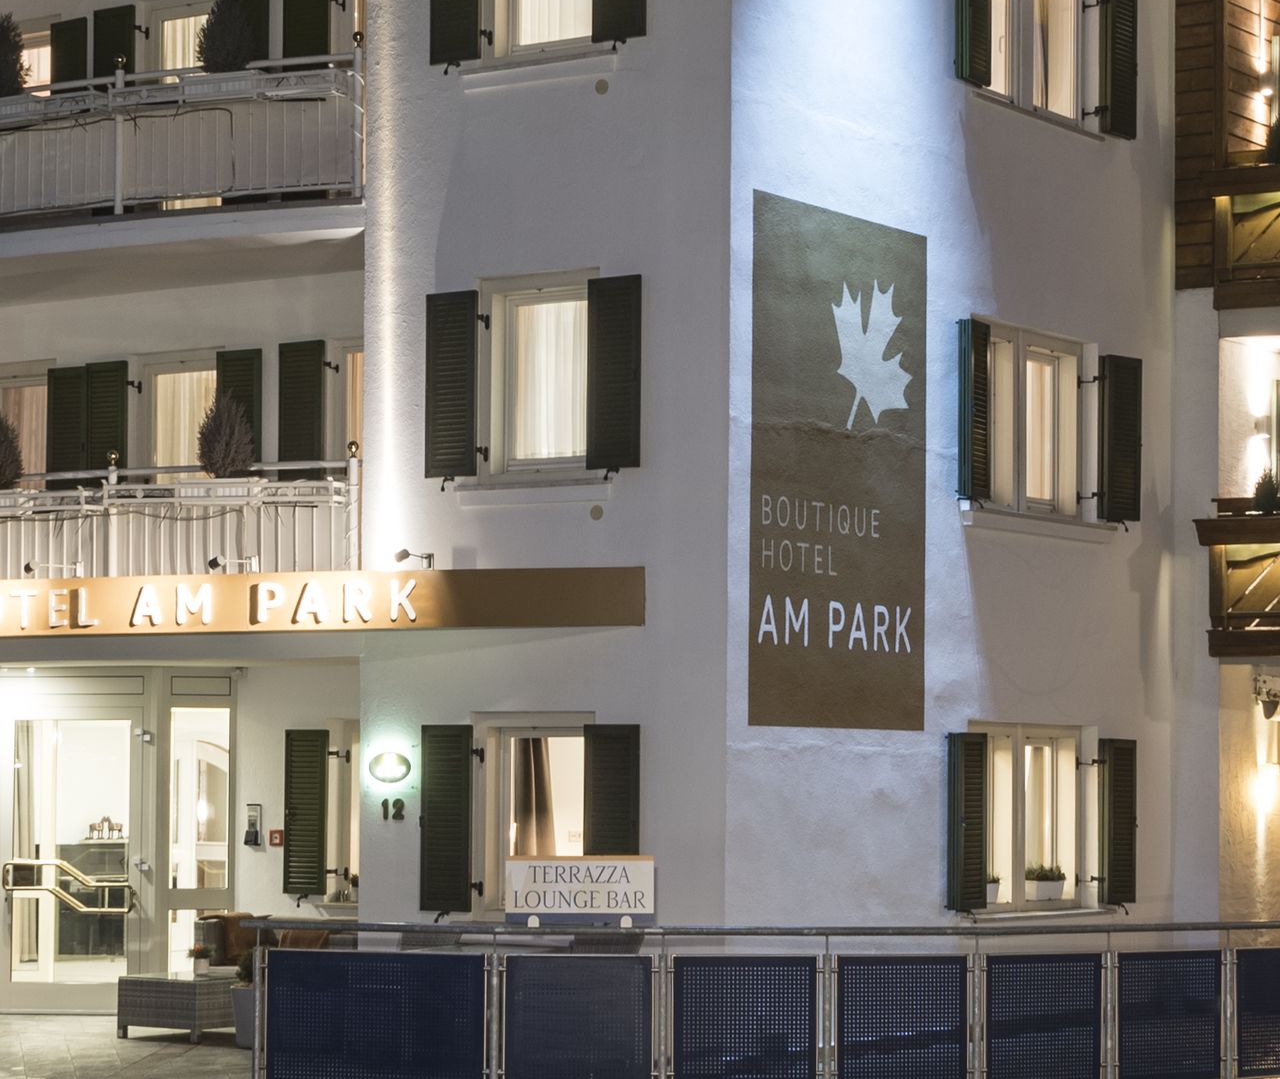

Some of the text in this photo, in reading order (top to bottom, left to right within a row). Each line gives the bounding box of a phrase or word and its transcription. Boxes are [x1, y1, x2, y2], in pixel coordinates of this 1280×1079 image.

[761, 494, 880, 538] BOUTIQUE
[761, 538, 838, 576] HOTEL
[129, 583, 213, 628] AM
[248, 578, 418, 626] PARK
[757, 594, 912, 654] AM PARK
[381, 798, 405, 820] 12
[528, 865, 631, 884] TERRAZZA
[514, 890, 646, 909] LOUNGE BAR
